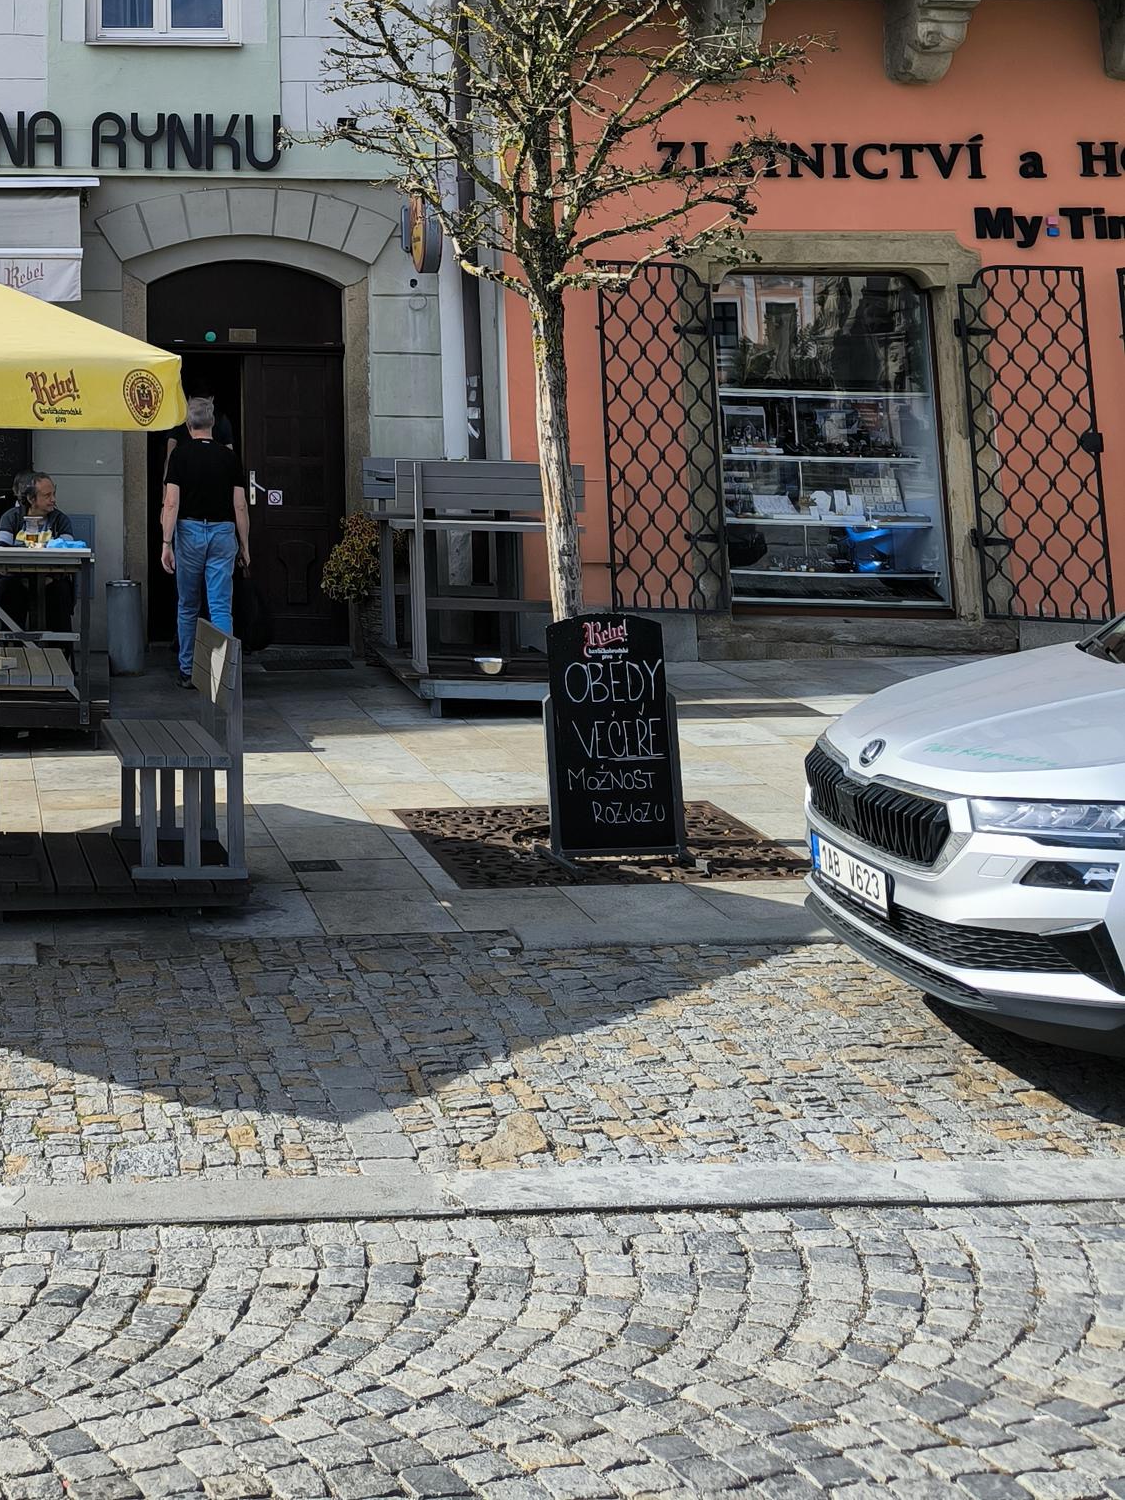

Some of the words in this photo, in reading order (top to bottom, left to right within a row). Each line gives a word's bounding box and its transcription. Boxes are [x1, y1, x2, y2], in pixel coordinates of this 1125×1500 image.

[92, 112, 282, 172] RYNKU
[1018, 151, 1048, 179] a
[1076, 141, 1125, 178] H
[4, 261, 45, 289] Rebel
[25, 368, 81, 422] Rebel
[582, 618, 629, 658] Rebel
[565, 654, 663, 703] OBĚDY
[571, 702, 665, 760] VEČEŘE
[567, 763, 656, 792] MOŽNOST
[592, 800, 666, 824] ROZVOZU
[847, 859, 881, 900] V623
